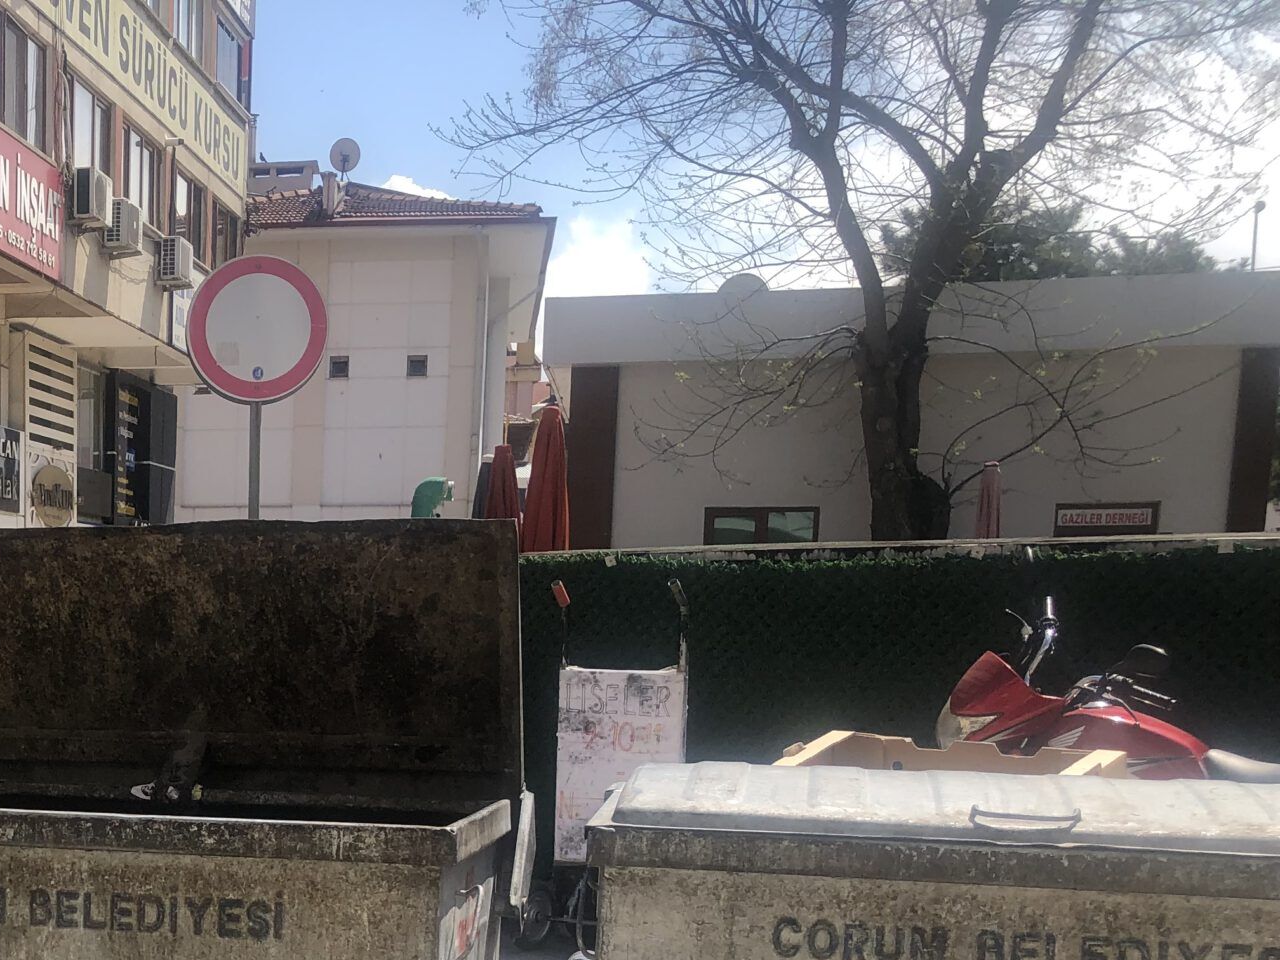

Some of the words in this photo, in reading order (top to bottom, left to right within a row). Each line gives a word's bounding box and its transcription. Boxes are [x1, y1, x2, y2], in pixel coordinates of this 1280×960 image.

[119, 14, 188, 131] SÜRÜCÜ
[194, 91, 240, 181] KURSU
[16, 153, 62, 242] İNŞAAT
[7, 229, 25, 250] 0532
[26, 239, 38, 258] 712
